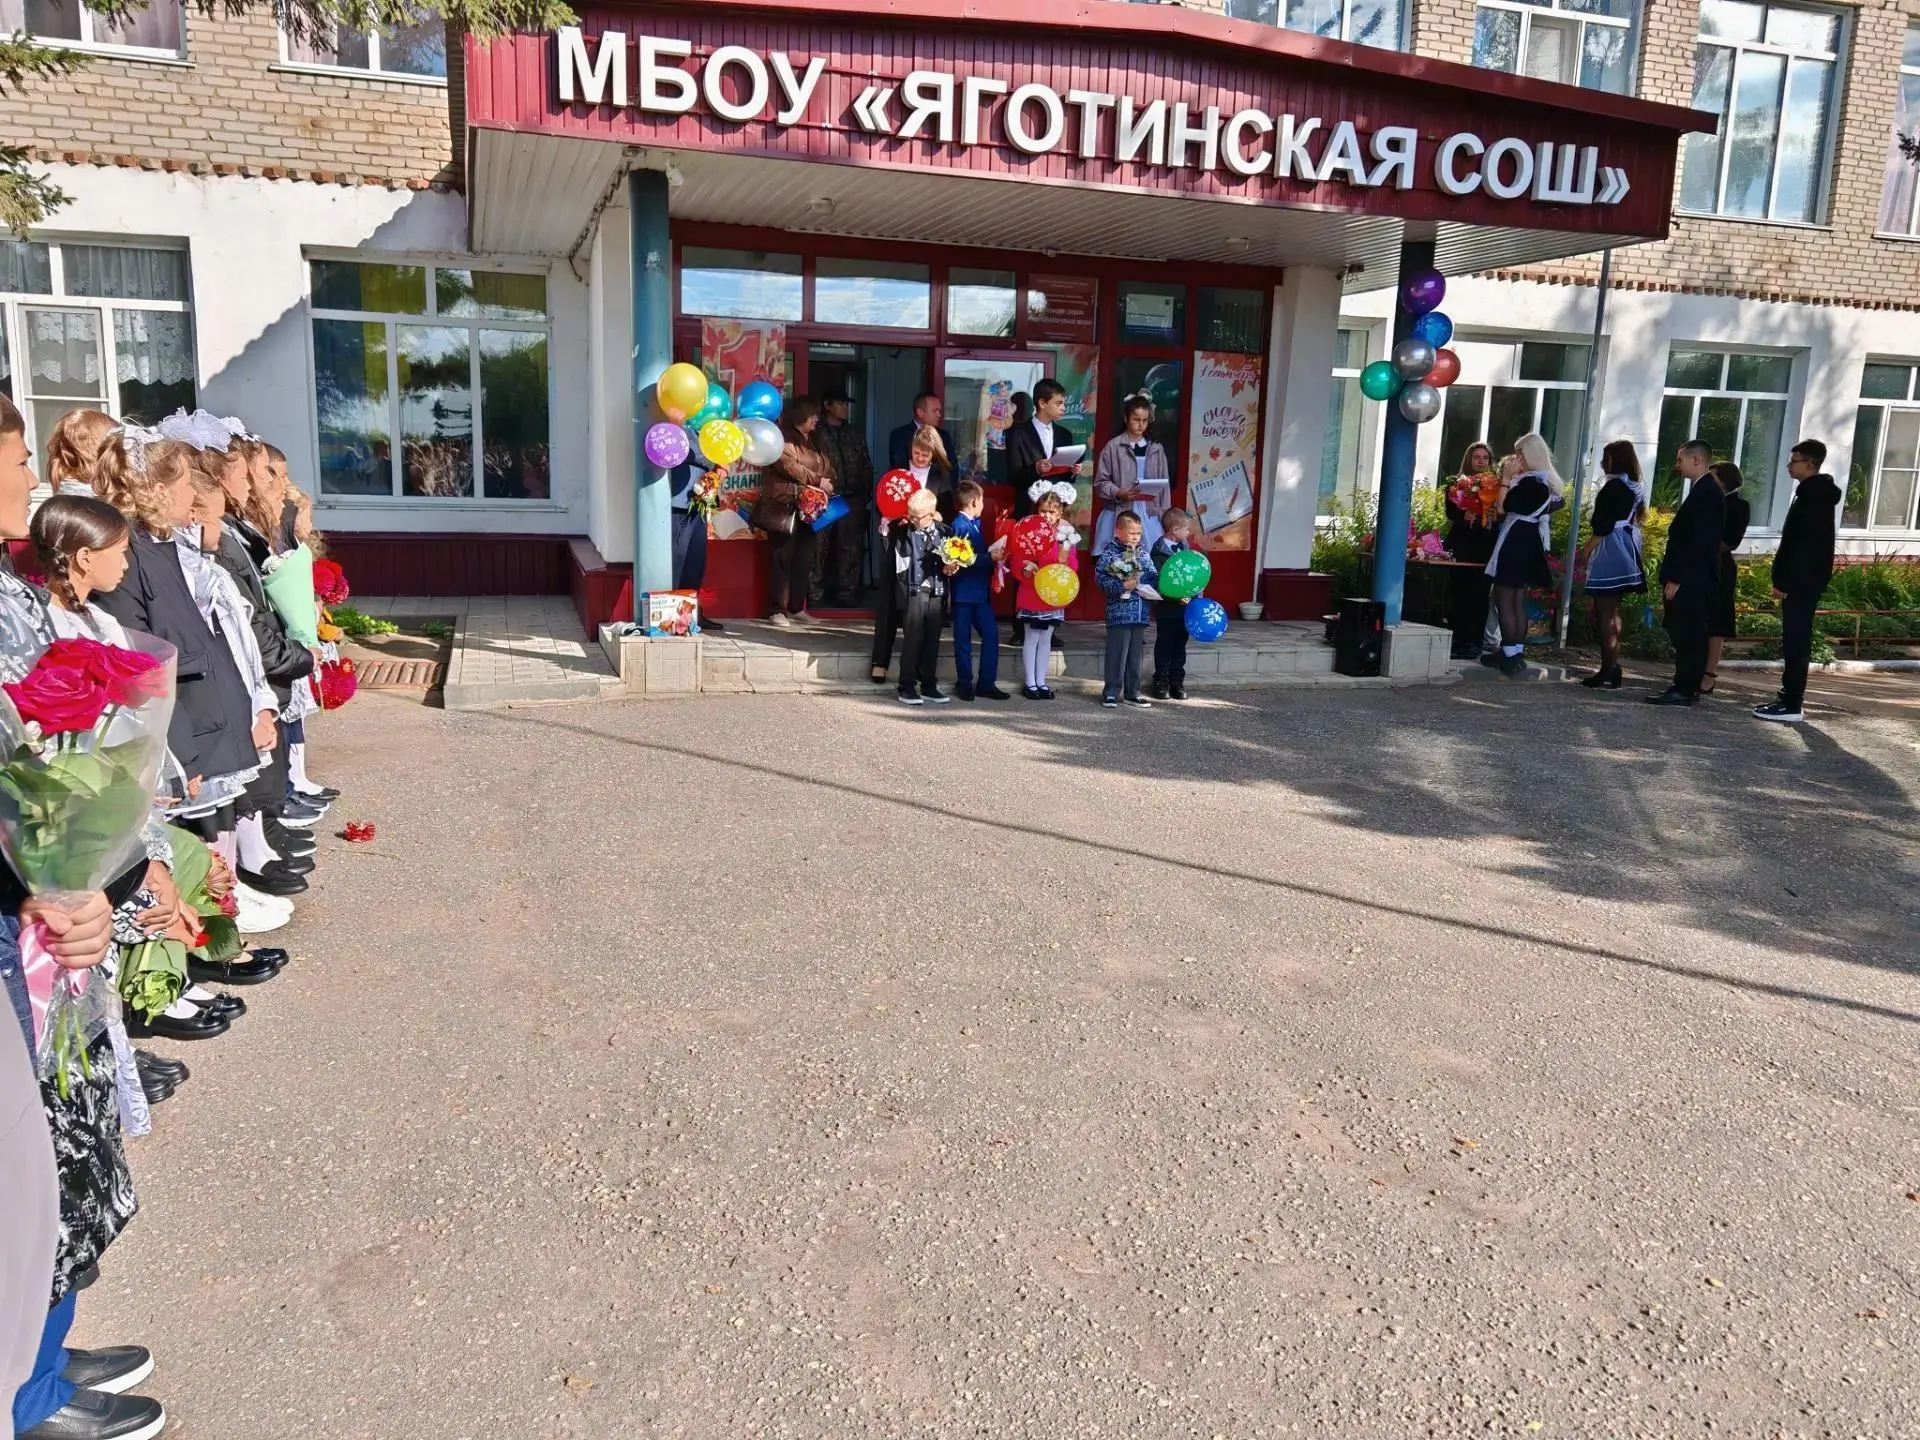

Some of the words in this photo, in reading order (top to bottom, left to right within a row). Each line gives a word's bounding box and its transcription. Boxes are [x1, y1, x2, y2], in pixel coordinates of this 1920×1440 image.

[558, 25, 827, 126] МБОУ
[852, 70, 1417, 190] «ЯГОТИНСКАЯ
[1434, 132, 1631, 205] СОШ»
